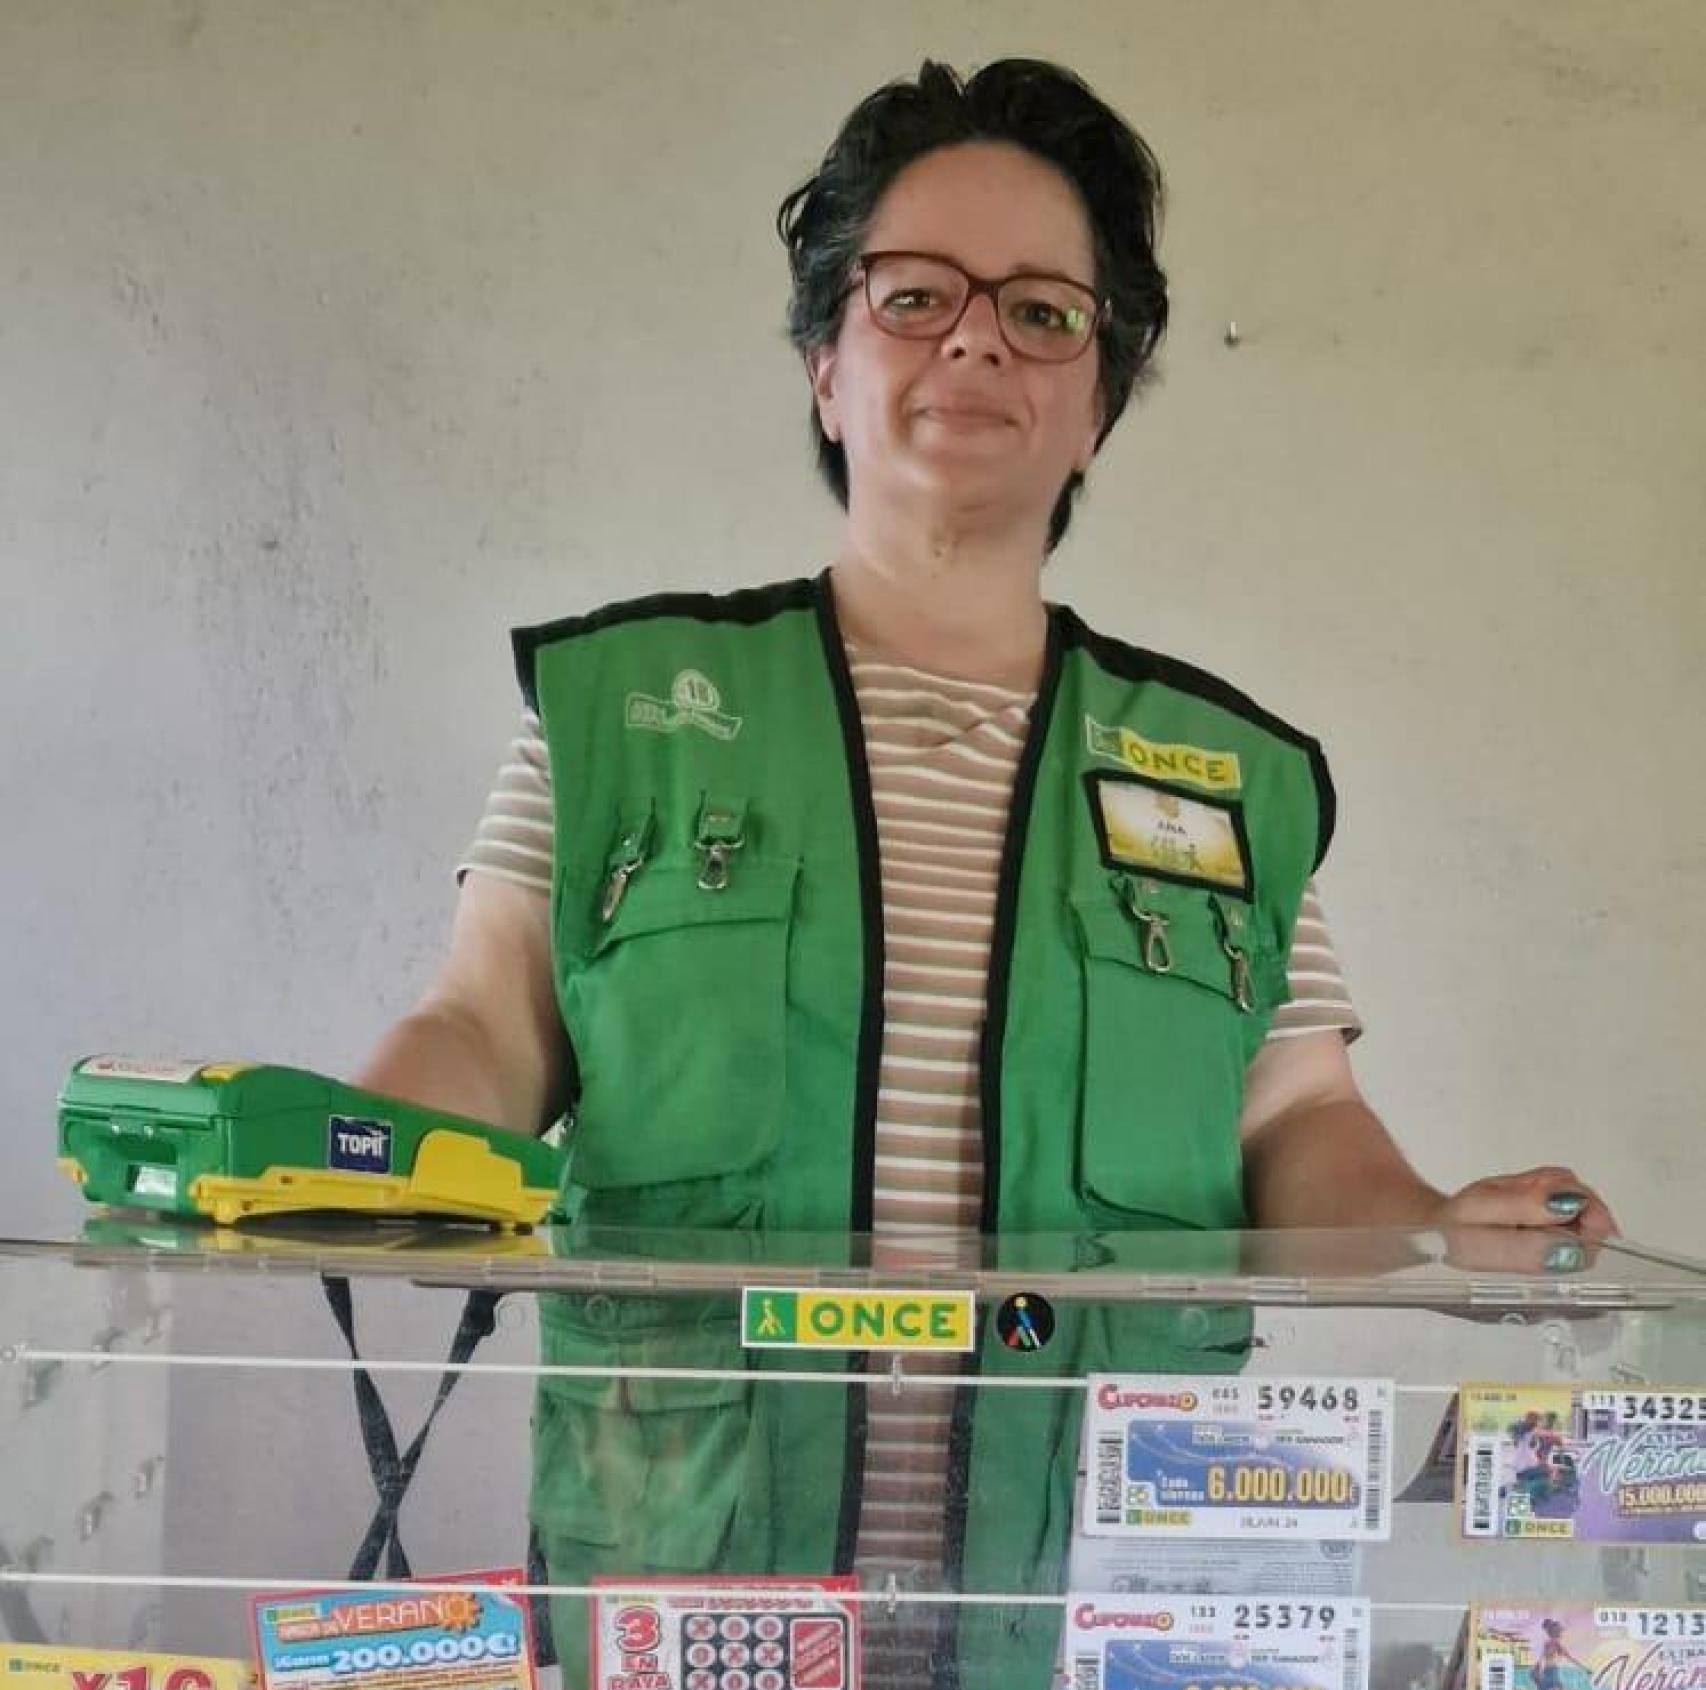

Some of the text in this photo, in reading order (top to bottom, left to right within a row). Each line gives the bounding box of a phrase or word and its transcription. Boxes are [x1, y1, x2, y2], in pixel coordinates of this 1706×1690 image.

[1130, 742, 1226, 782] ONCE
[811, 1301, 957, 1337] ONCE
[1257, 1384, 1359, 1412] 59468
[1142, 1510, 1191, 1525] ONCE
[1524, 1522, 1568, 1534] ONCE
[615, 1605, 661, 1653] 3
[1234, 1604, 1335, 1630] 25379
[621, 1654, 658, 1673] EN
